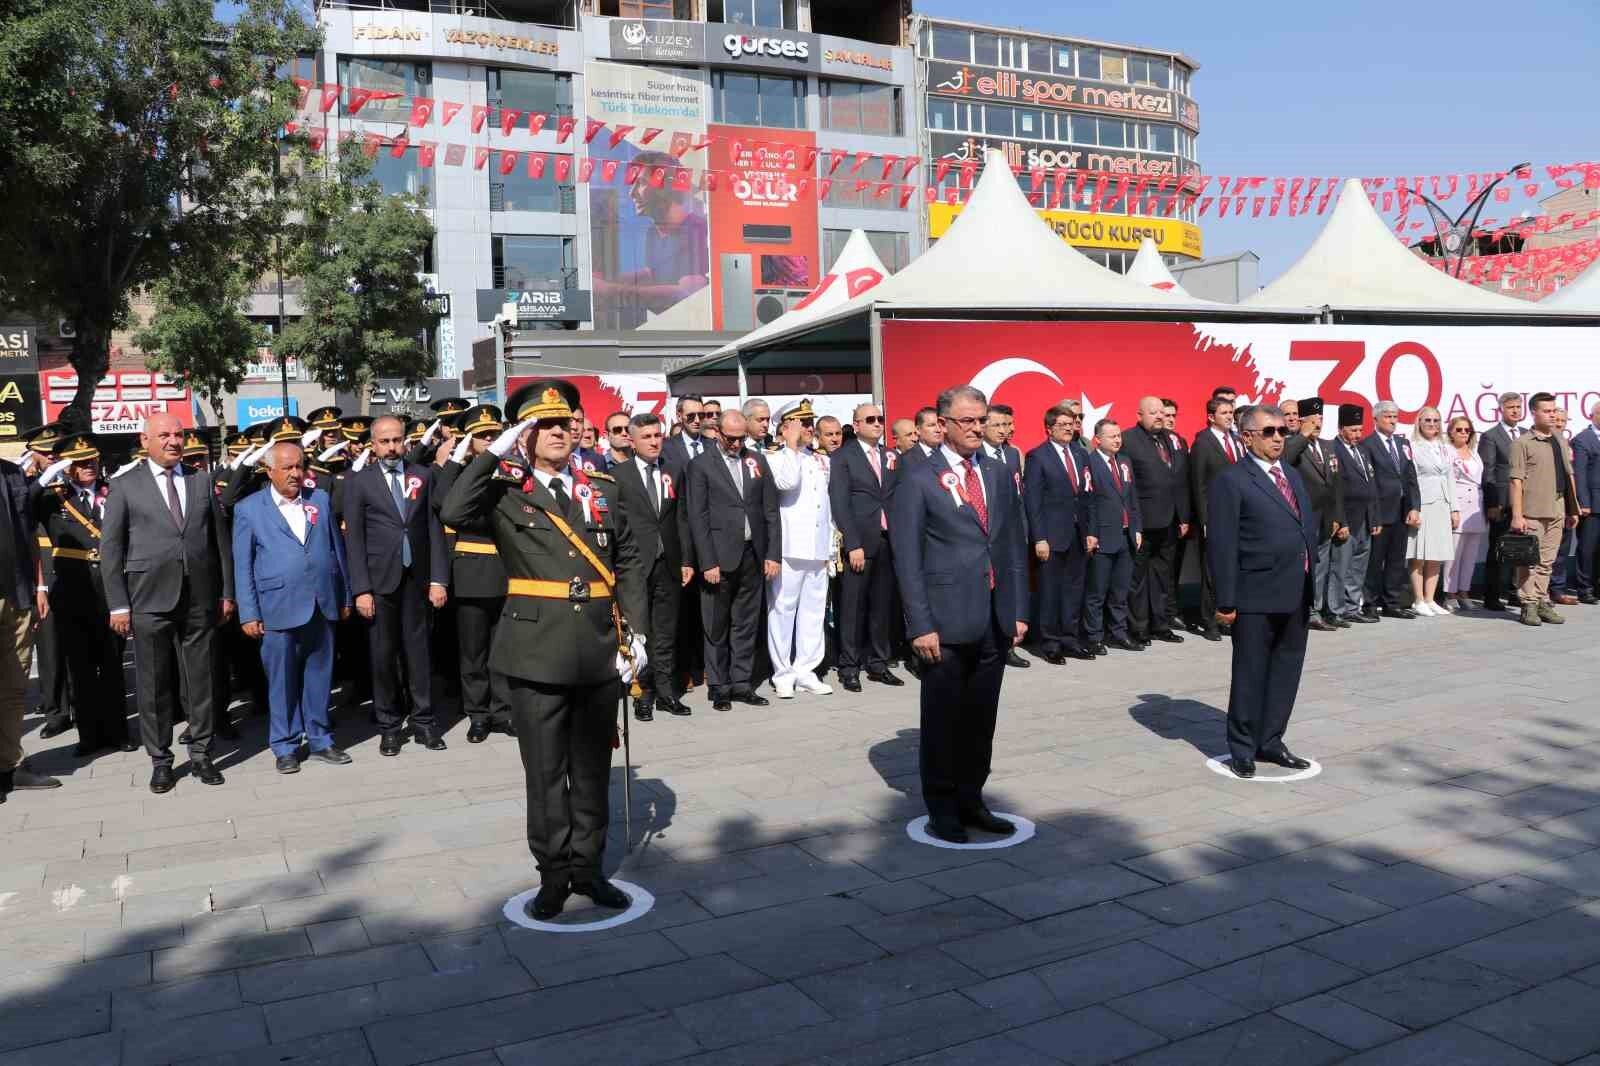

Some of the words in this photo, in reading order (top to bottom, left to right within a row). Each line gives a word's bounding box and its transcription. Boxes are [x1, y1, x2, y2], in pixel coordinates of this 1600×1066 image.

[646, 35, 692, 48] KUZEY
[723, 34, 809, 59] gürses
[637, 90, 661, 102] fiber
[662, 93, 699, 104] internet
[1022, 79, 1077, 105] spor
[1082, 87, 1172, 113] merkezi
[601, 101, 628, 113] Türk
[1087, 152, 1177, 178] merkezi
[1289, 340, 1443, 440] 30
[100, 423, 139, 431] SERHAT
